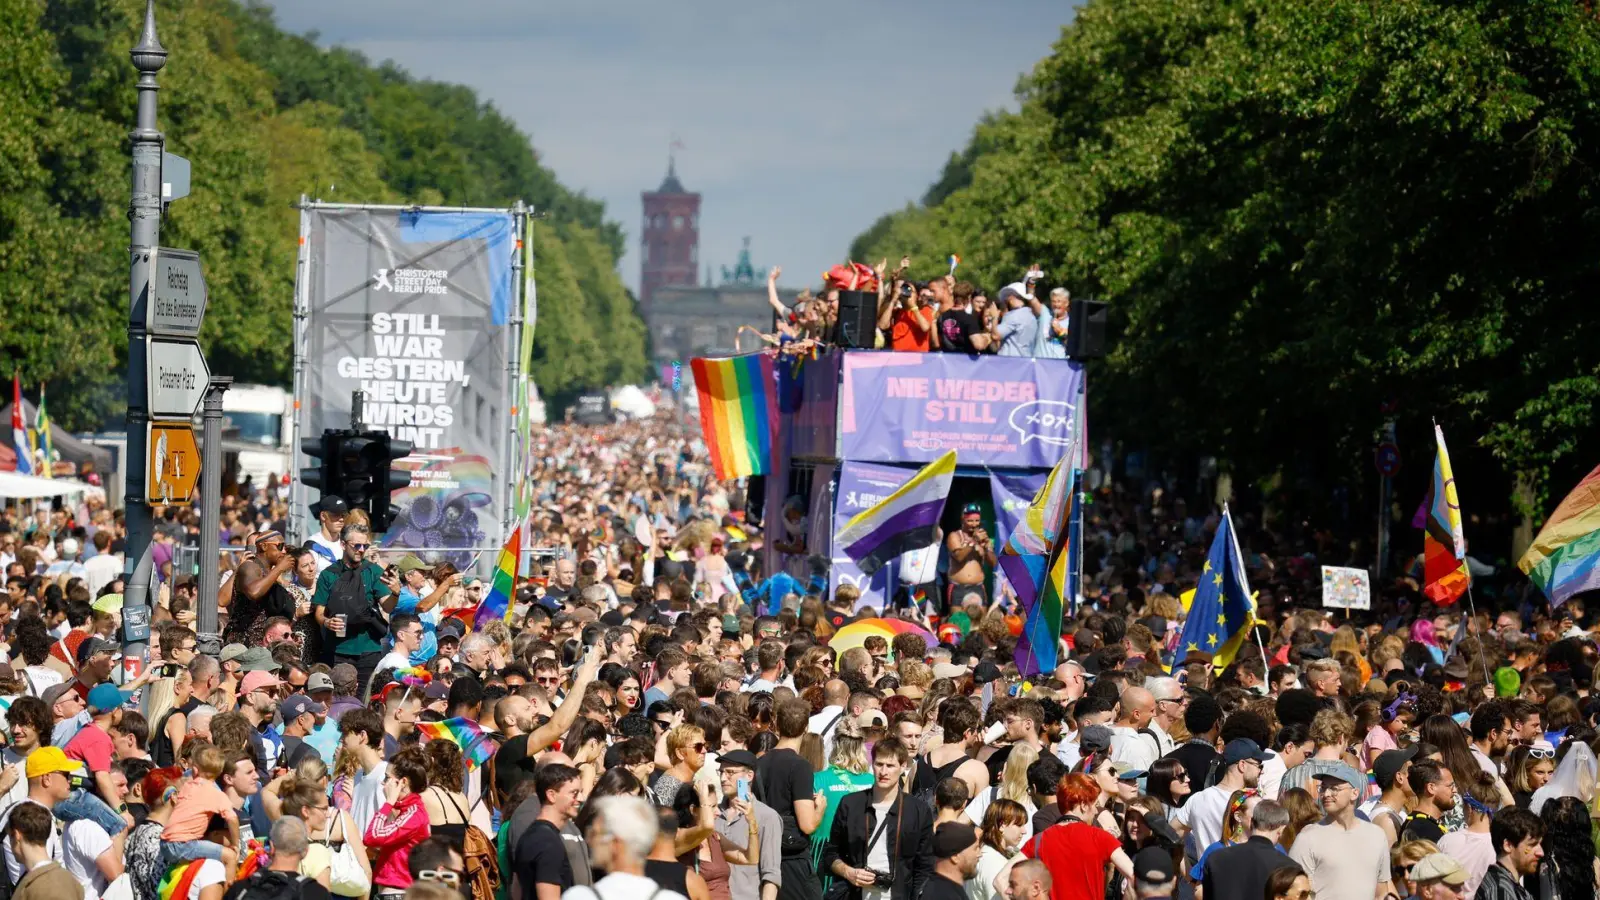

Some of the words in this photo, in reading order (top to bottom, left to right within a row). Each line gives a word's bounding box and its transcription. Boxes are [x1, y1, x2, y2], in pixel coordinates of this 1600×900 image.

[168, 264, 189, 296] Reichstag
[395, 269, 448, 279] CHRISTOPHER
[395, 278, 424, 286] STREET
[425, 278, 442, 286] DAY
[395, 285, 423, 293] BERLIN
[424, 286, 448, 294] PRIDE
[157, 297, 165, 316] Sitz
[165, 298, 173, 317] des
[173, 298, 197, 322] Bundestages
[371, 312, 446, 336] STILL
[373, 335, 443, 358] WAR
[160, 365, 182, 390] Potsdamer
[182, 367, 195, 390] Platz
[337, 356, 471, 387] GESTERN,
[361, 379, 447, 404] HEUTE
[887, 377, 929, 398] NIE
[935, 379, 1037, 402] WIEDER
[362, 402, 454, 427] WIRDS
[925, 401, 996, 424] STILL
[367, 425, 444, 449] UNT
